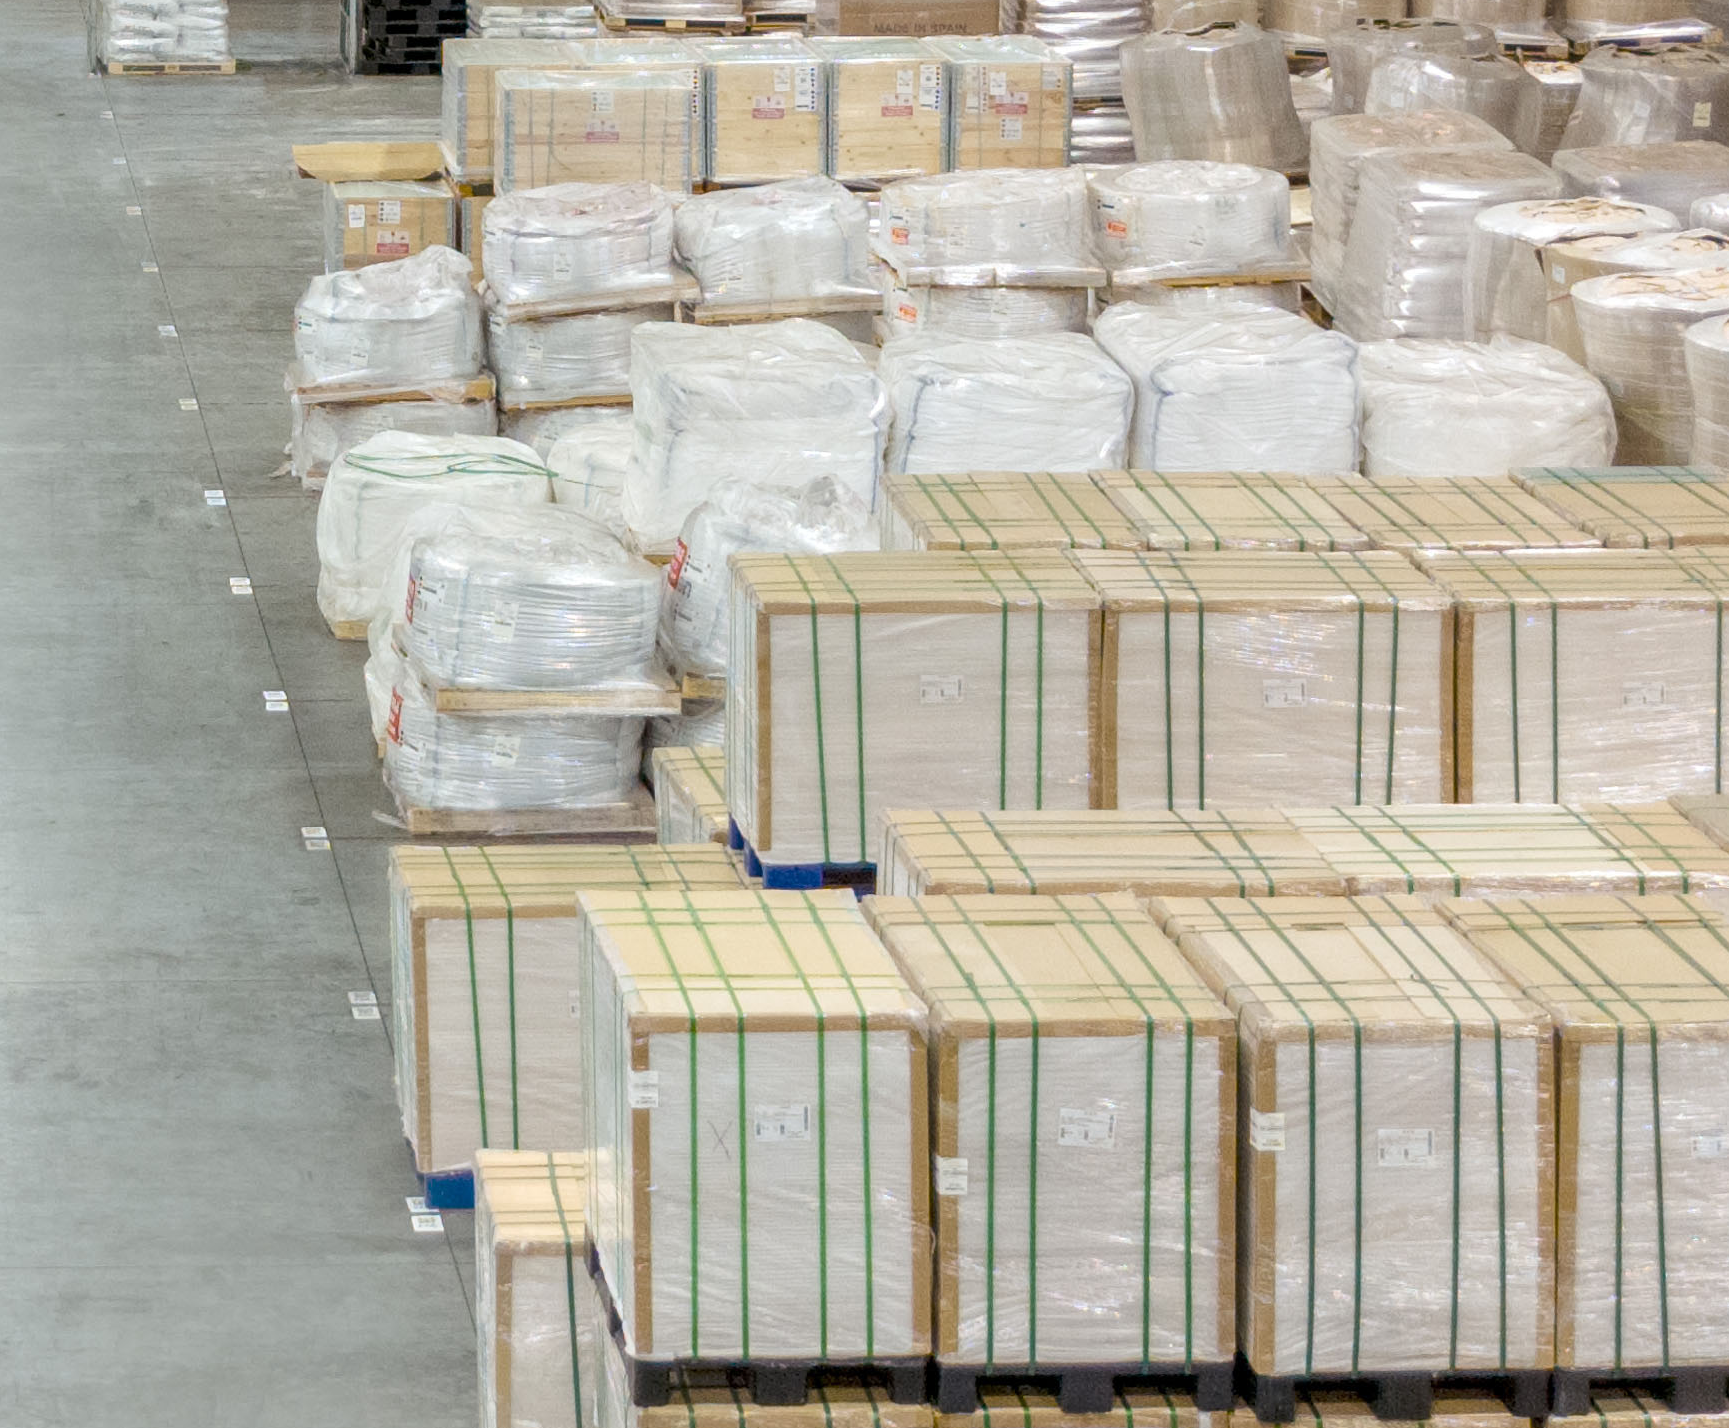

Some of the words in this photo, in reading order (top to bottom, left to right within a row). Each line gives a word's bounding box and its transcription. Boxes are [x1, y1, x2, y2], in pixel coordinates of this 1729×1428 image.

[873, 22, 909, 34] MADE
[914, 23, 927, 33] IN
[930, 22, 968, 34] SPAIN
